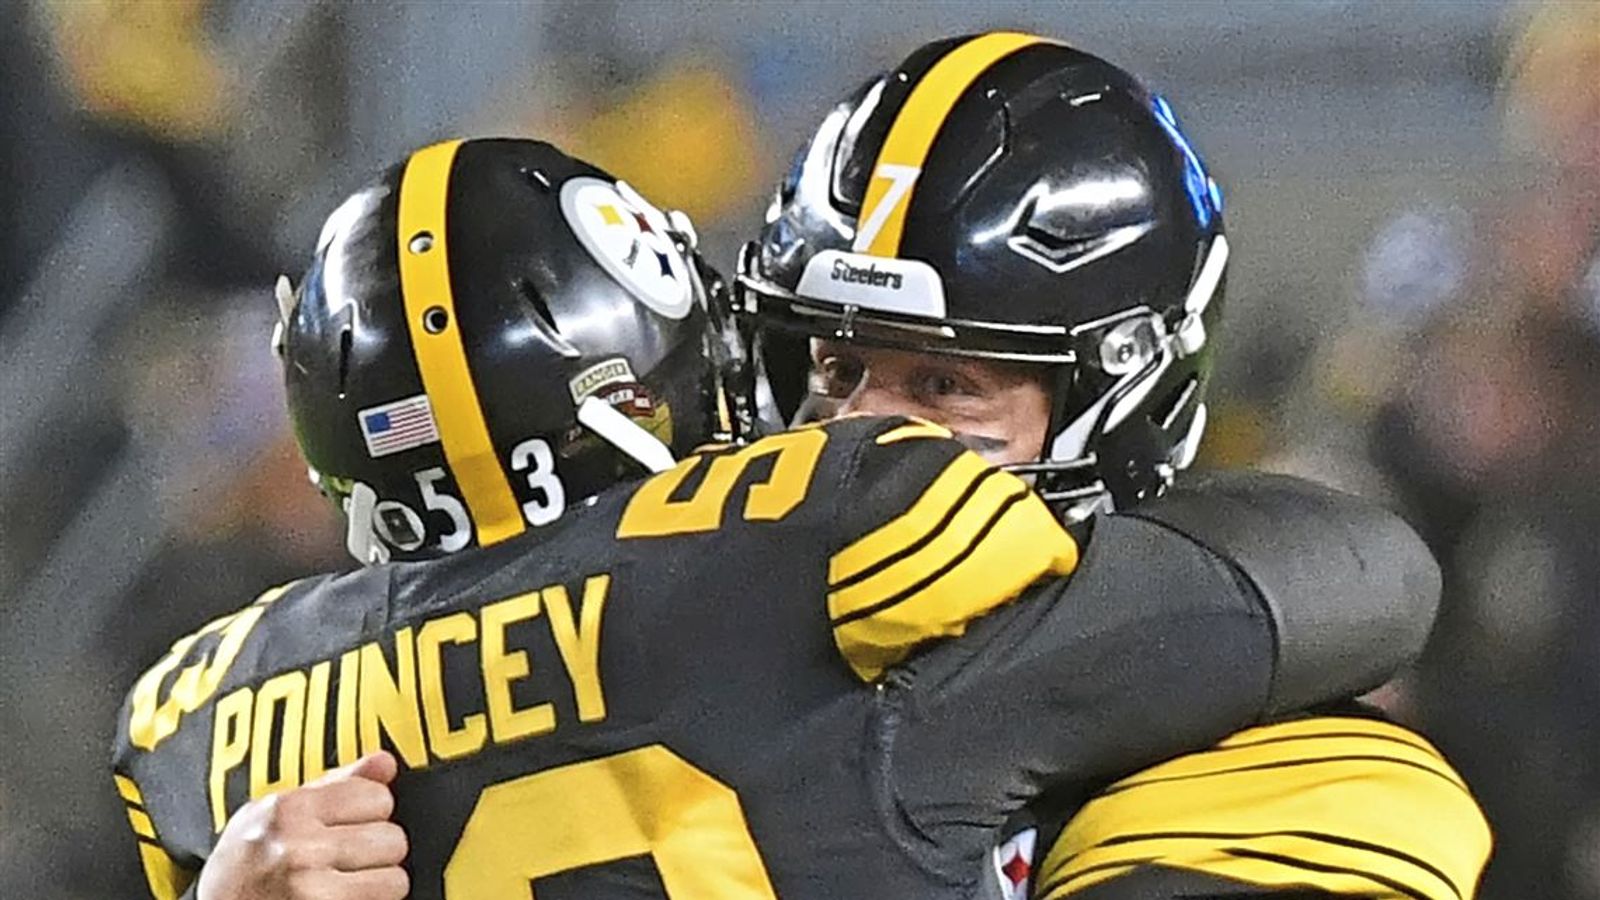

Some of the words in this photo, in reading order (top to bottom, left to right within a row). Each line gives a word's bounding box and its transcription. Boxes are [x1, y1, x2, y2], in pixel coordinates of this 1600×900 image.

[852, 164, 922, 252] 7
[831, 258, 903, 290] Steelers
[209, 573, 611, 834] POUNCEY
